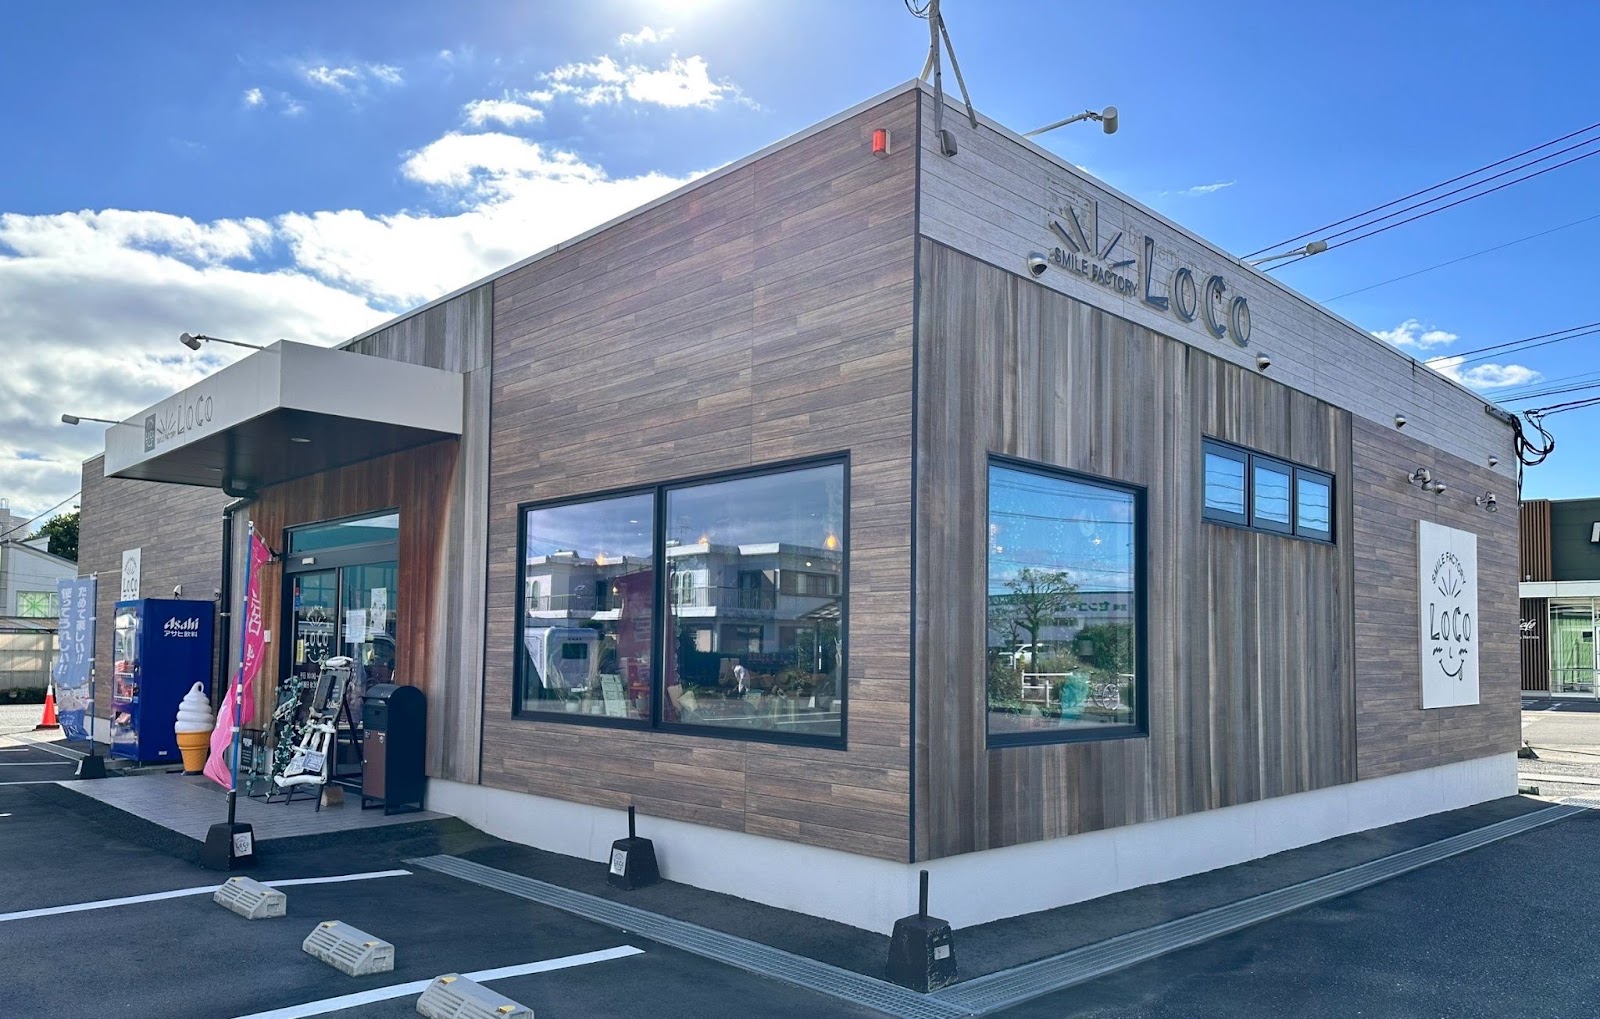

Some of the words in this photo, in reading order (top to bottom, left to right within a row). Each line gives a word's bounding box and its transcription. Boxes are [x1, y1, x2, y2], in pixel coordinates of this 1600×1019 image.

[1053, 246, 1088, 274] SMILE
[1091, 263, 1138, 296] FACTORY
[1431, 552, 1446, 584] SMILE
[1445, 551, 1467, 585] FACTORY
[163, 616, 200, 630] Asahi
[163, 630, 198, 638] アサヒ飲料
